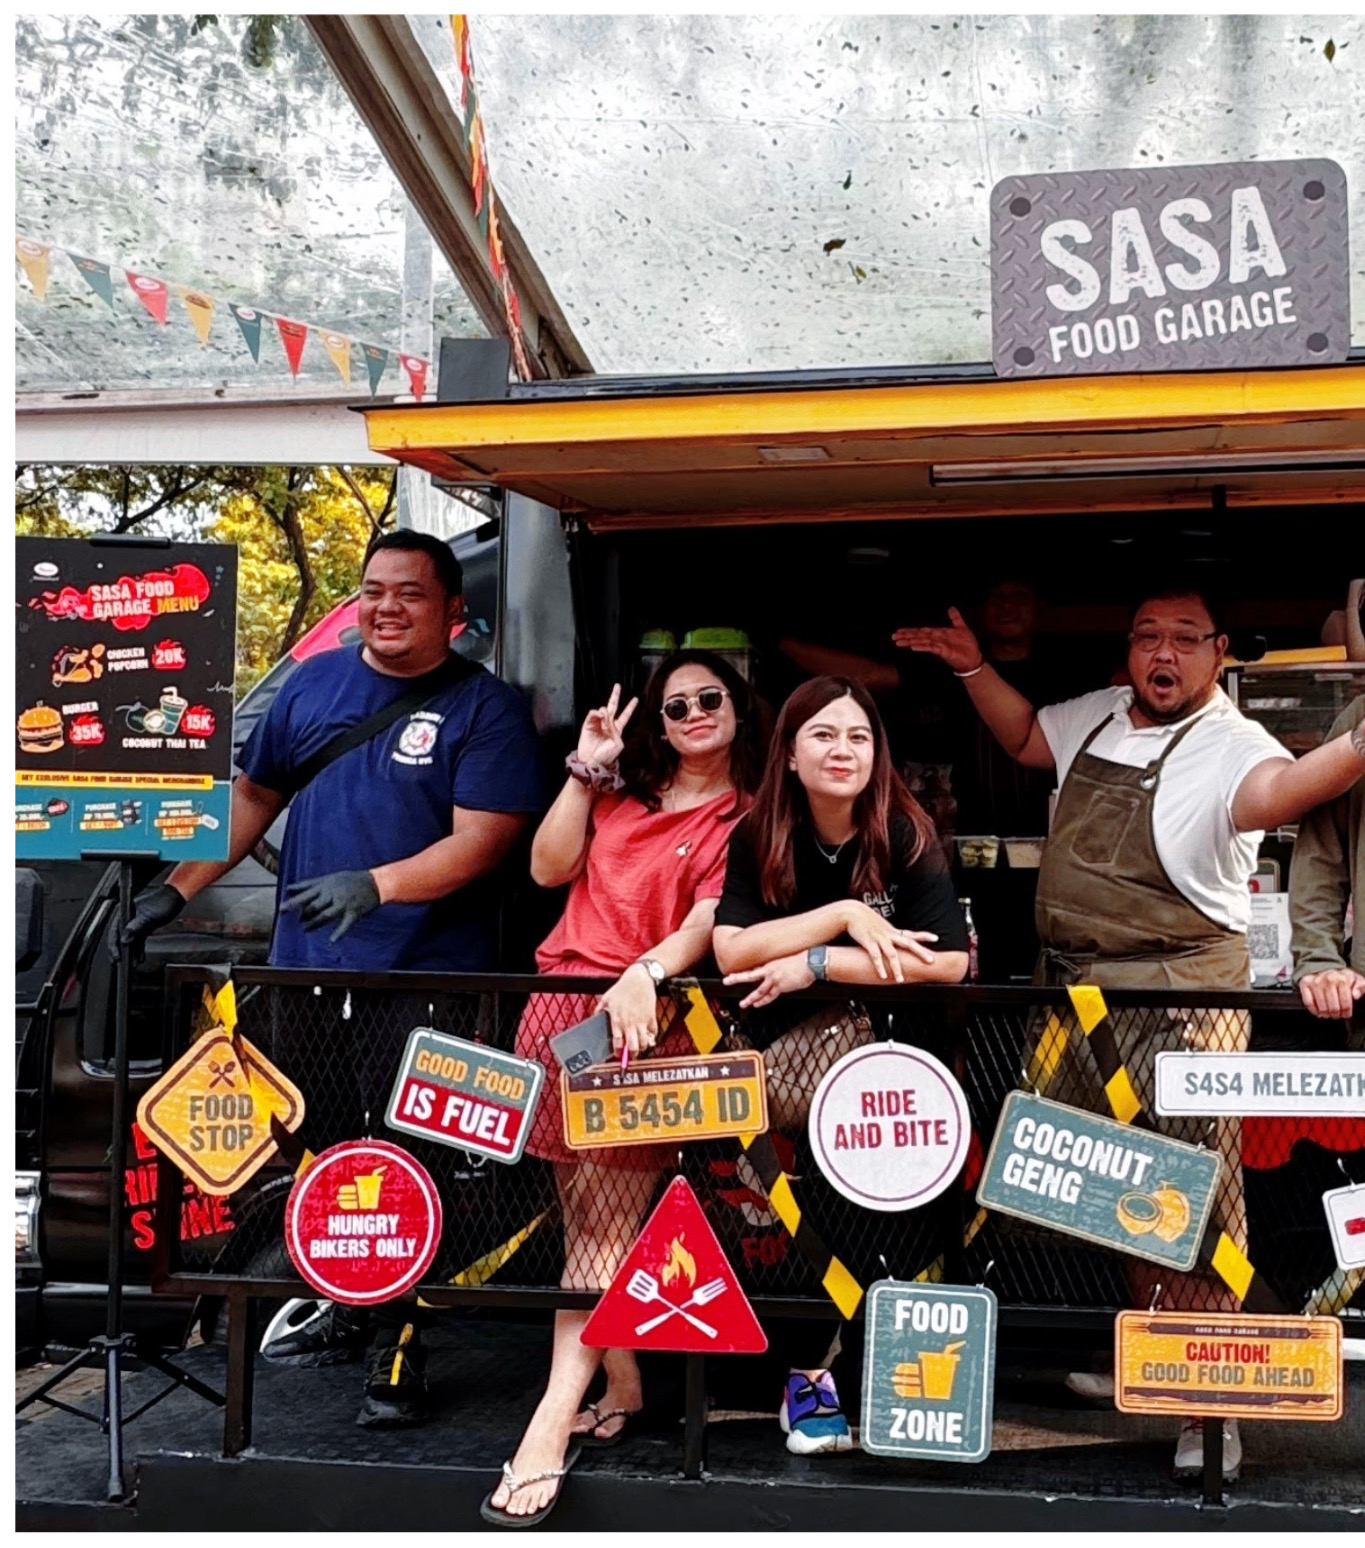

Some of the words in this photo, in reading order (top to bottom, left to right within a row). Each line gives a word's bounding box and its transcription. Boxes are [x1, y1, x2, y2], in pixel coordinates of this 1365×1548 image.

[1040, 185, 1288, 312] SASA
[1049, 314, 1140, 364] FOOD
[1155, 286, 1297, 344] GARAGE
[91, 584, 131, 601] SASA
[136, 581, 175, 598] FOOD
[92, 599, 151, 619] GARAGE
[157, 596, 200, 614] MENU
[155, 649, 184, 665] 20K
[72, 724, 103, 741] 35K
[186, 714, 212, 730] 15K
[189, 738, 206, 749] TEA
[414, 1049, 467, 1085] GOOD
[473, 1065, 526, 1102] FOOD
[642, 1066, 709, 1084] MELEZATKAN
[1184, 1071, 1244, 1097] S4S4
[189, 1094, 254, 1122] FOOD
[402, 1082, 435, 1119] IS
[441, 1094, 512, 1147] FUEL
[584, 1097, 606, 1134] B
[619, 1089, 705, 1131] 5454
[716, 1086, 750, 1123] ID
[860, 1088, 918, 1118] RIDE
[189, 1124, 254, 1152] STOP
[833, 1123, 883, 1150] AND
[893, 1119, 949, 1148] BITE
[1012, 1115, 1153, 1186] COCONUT
[1002, 1154, 1083, 1205] GENG
[327, 1214, 400, 1236] HUNGRY
[310, 1238, 370, 1259] BIKERS
[375, 1238, 417, 1258] ONLY
[893, 1299, 969, 1335] FOOD
[1185, 1341, 1271, 1364] CAUTION!
[1141, 1361, 1190, 1383] GOOD
[1197, 1364, 1245, 1385] FOOD
[1253, 1366, 1315, 1388] AHEAD
[888, 1407, 964, 1443] ZONE
